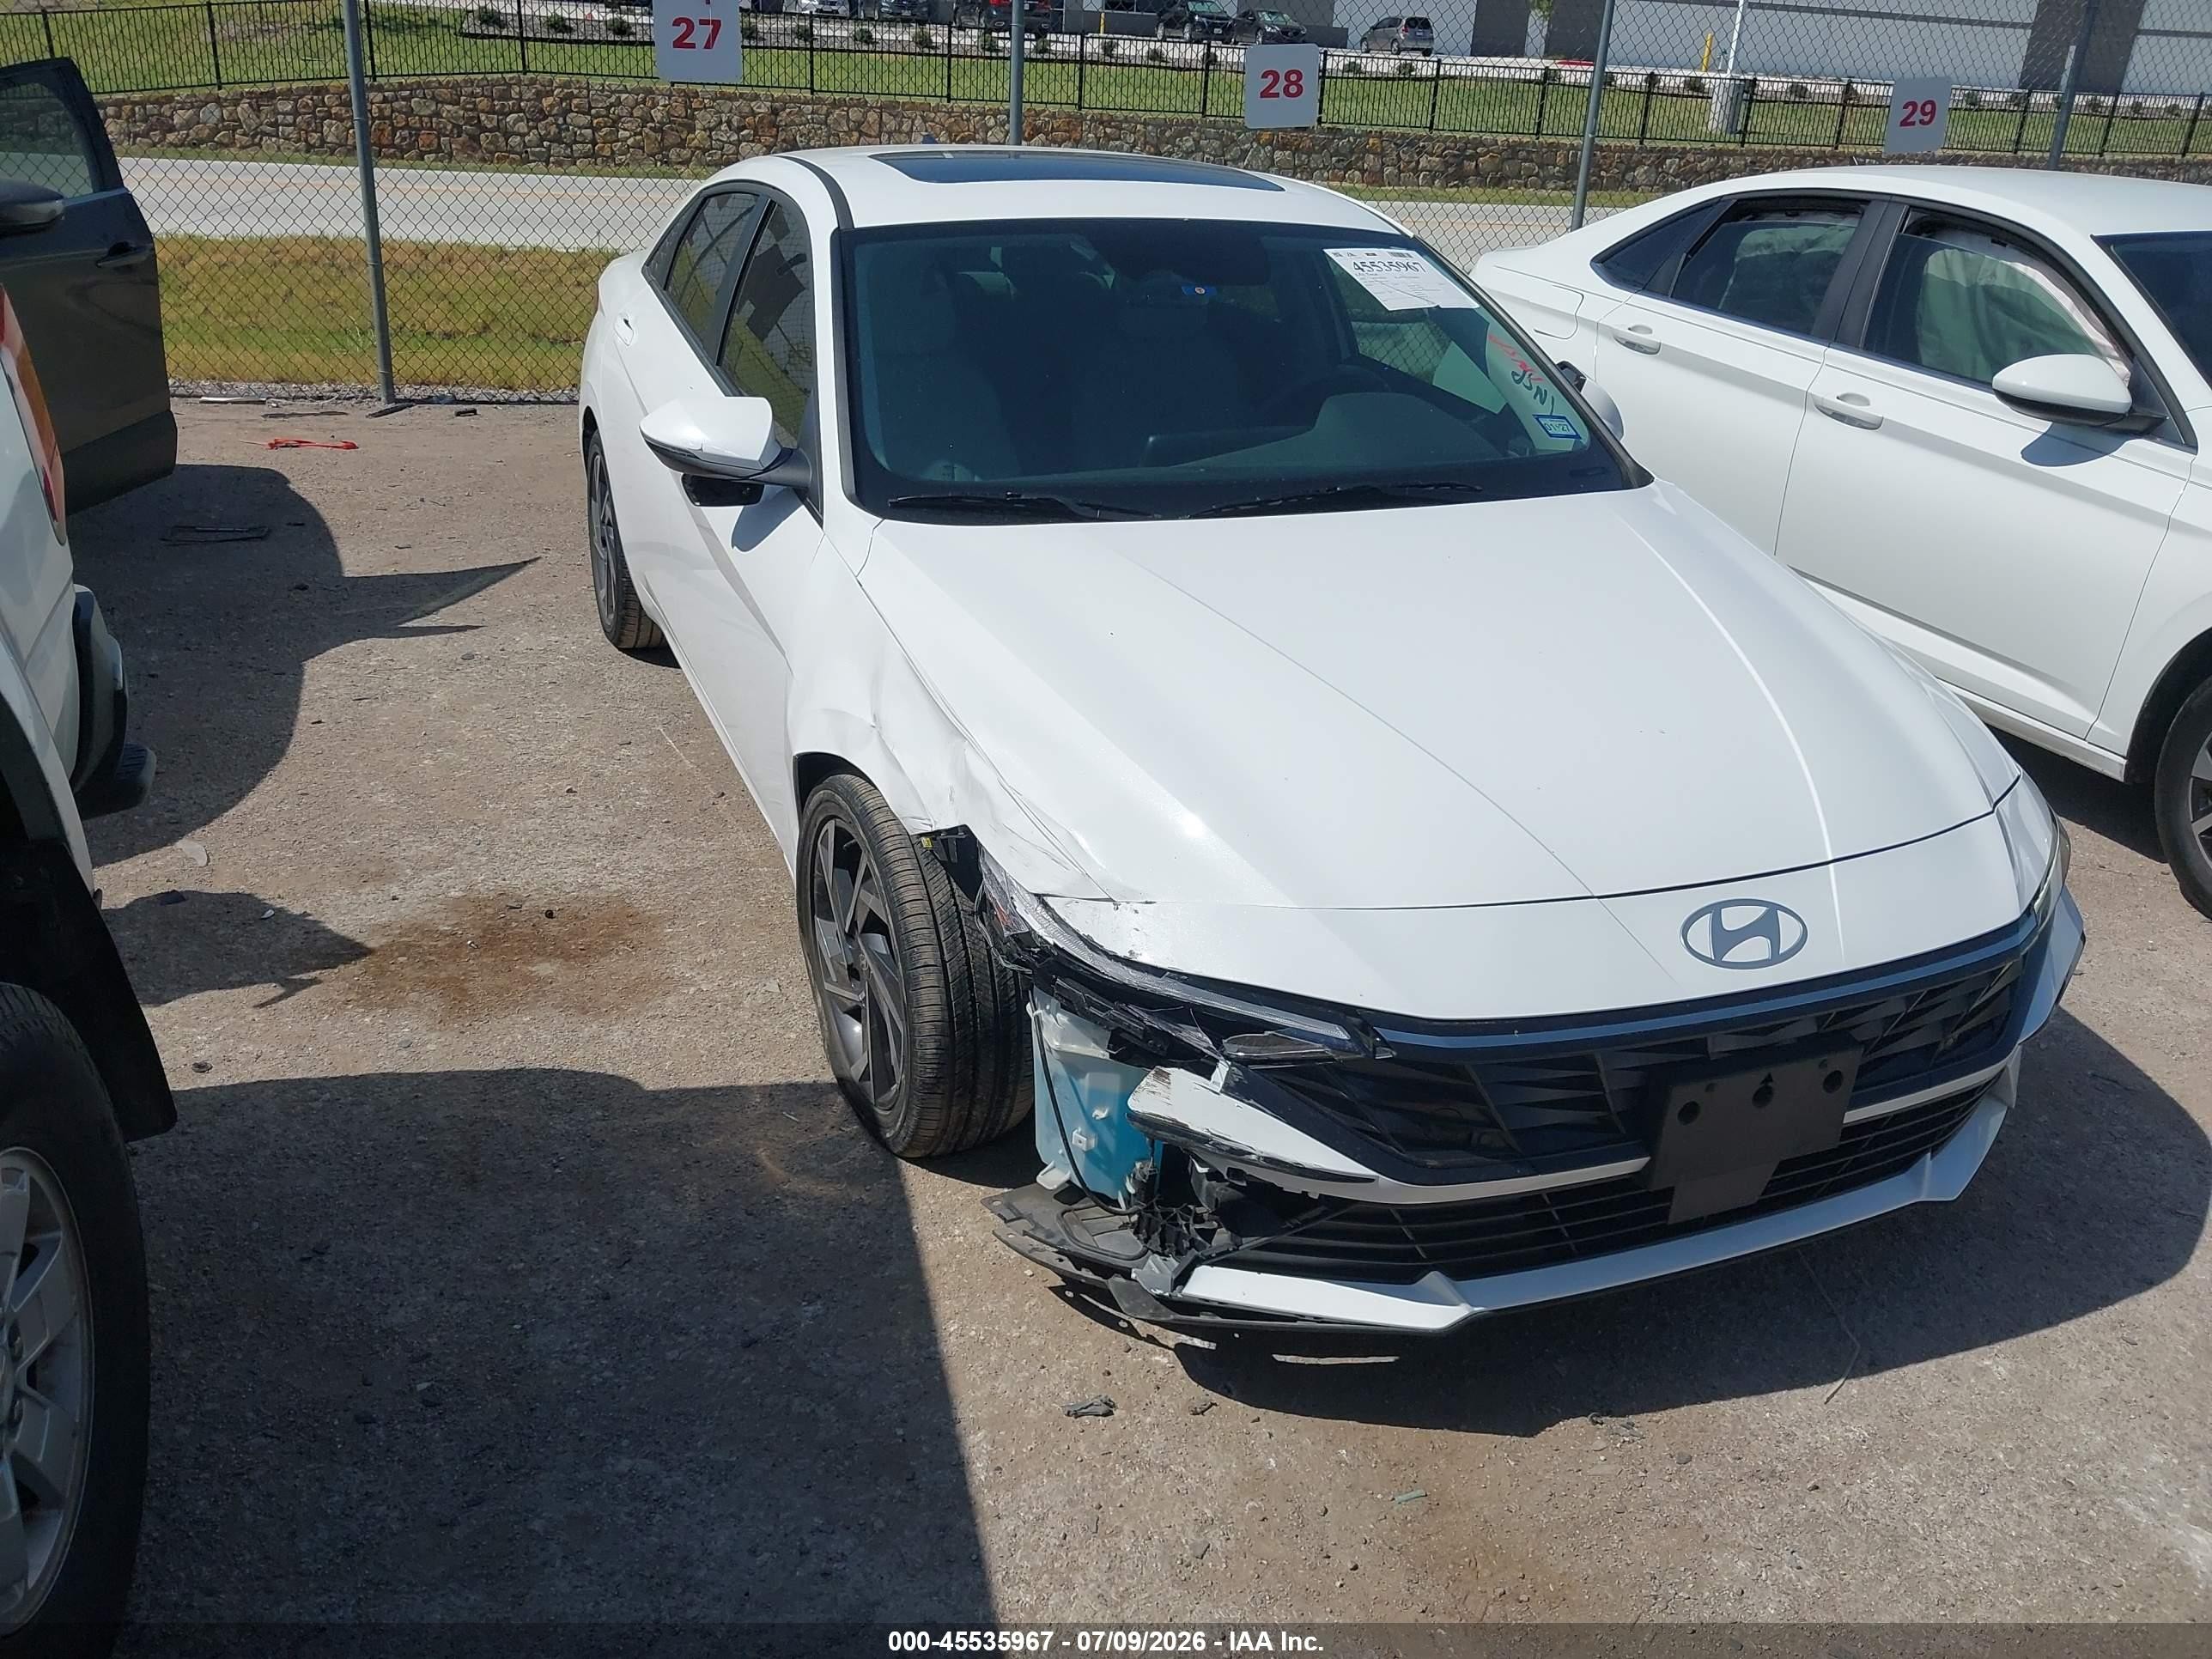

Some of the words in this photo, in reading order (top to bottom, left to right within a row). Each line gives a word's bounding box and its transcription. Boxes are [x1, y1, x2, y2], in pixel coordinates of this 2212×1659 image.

[672, 17, 721, 49] 27
[1260, 70, 1304, 98] 28
[1899, 100, 1936, 127] 29
[1353, 261, 1425, 272] 45535967
